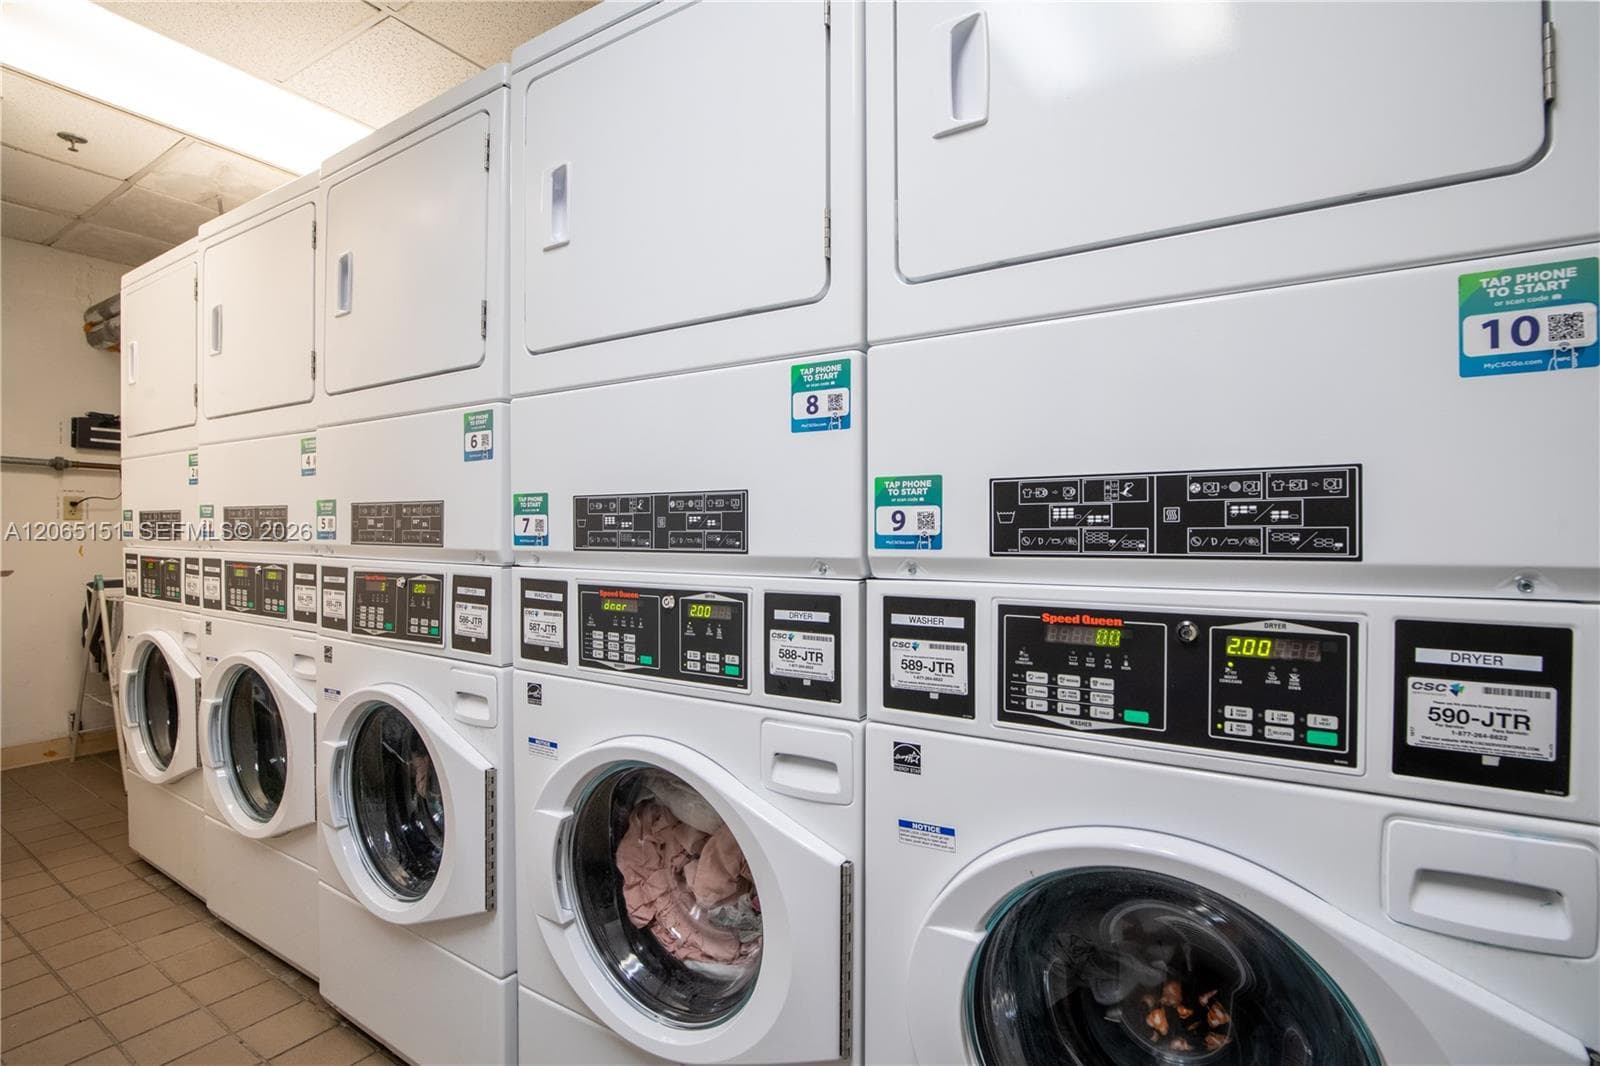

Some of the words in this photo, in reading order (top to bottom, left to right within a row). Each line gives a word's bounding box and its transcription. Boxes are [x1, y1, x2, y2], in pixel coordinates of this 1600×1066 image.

[1480, 276, 1512, 288] TAP
[1516, 267, 1577, 284] PHONE
[1486, 287, 1509, 298] TO
[1514, 279, 1570, 295] START
[1527, 295, 1549, 303] code
[1481, 315, 1540, 349] 10
[800, 367, 814, 375] TAP
[816, 364, 842, 373] PHONE
[1483, 359, 1543, 369] MyCSCGo.com
[815, 372, 838, 380] START
[806, 395, 819, 415] 8
[471, 435, 478, 449] 6
[306, 455, 311, 467] 4
[884, 481, 900, 489] TAP
[902, 480, 932, 488] PHONE
[901, 488, 929, 496] START
[321, 518, 326, 529] 5
[522, 518, 530, 533] 7
[891, 510, 906, 532] 9
[789, 611, 813, 620] DRYER
[909, 616, 945, 625] WASHER
[1042, 612, 1080, 625] Speed
[1082, 615, 1123, 626] Queen
[529, 622, 557, 633] 587-JTR
[1264, 622, 1287, 630] DRYER
[1226, 638, 1271, 657] 2.00
[778, 648, 824, 662] 588-JTR
[1450, 652, 1504, 666] DRYER
[900, 659, 955, 674] 589-JTR
[1411, 681, 1447, 692] CSC
[1070, 719, 1093, 728] WASHER
[1427, 706, 1532, 731] 590-JTR
[911, 822, 941, 833] NOTICE
